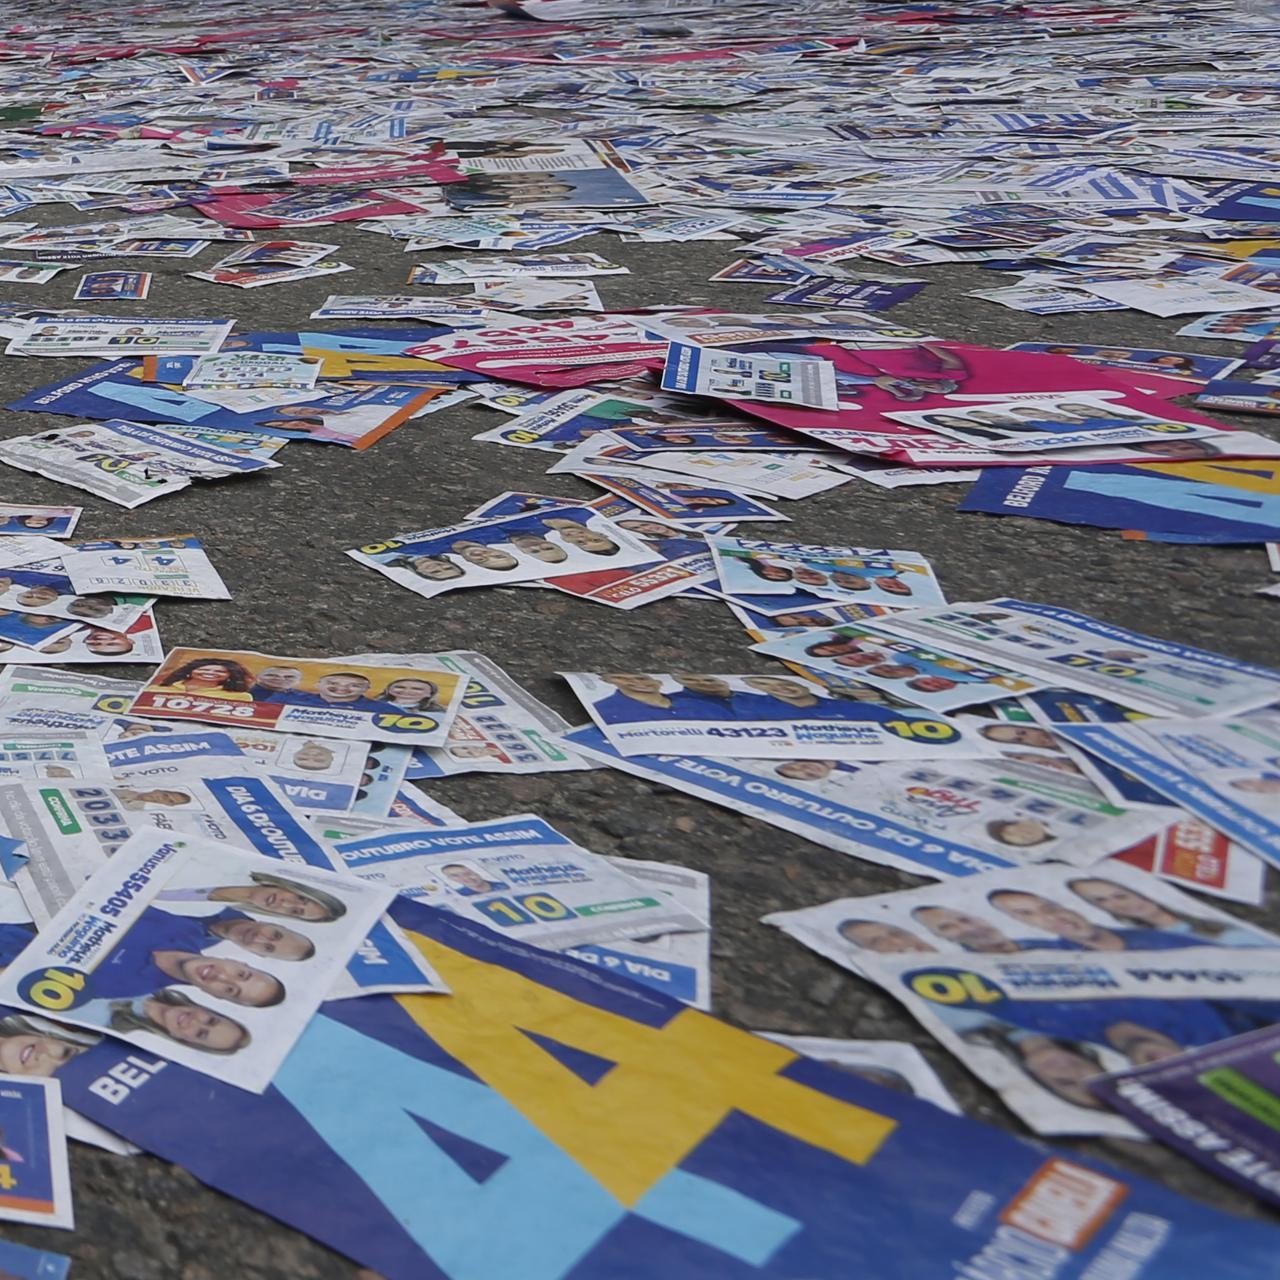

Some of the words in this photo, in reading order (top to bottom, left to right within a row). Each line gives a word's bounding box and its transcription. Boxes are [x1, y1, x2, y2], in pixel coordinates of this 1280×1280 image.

[151, 695, 258, 718] 10728
[378, 713, 437, 730] 10
[884, 720, 954, 739] 10
[143, 740, 212, 757] ASSIM
[225, 785, 249, 802] DIA
[286, 785, 328, 801] DIA
[673, 755, 742, 788] VOTE
[745, 780, 877, 831] OUTUBRO
[885, 829, 917, 848] DE
[340, 837, 433, 861] OUTUBRO
[432, 831, 485, 849] VOTE
[485, 828, 544, 843] ASSIM
[500, 863, 586, 879] Matheus.
[98, 868, 150, 919] 55405
[486, 895, 564, 923] 10
[46, 914, 100, 961] Waguinho
[67, 922, 118, 966] Matheus.
[625, 963, 672, 983] DIA
[911, 971, 1004, 1004] 10
[29, 968, 88, 1011] 10
[89, 1054, 168, 1108] BEL
[270, 923, 900, 1280] 44
